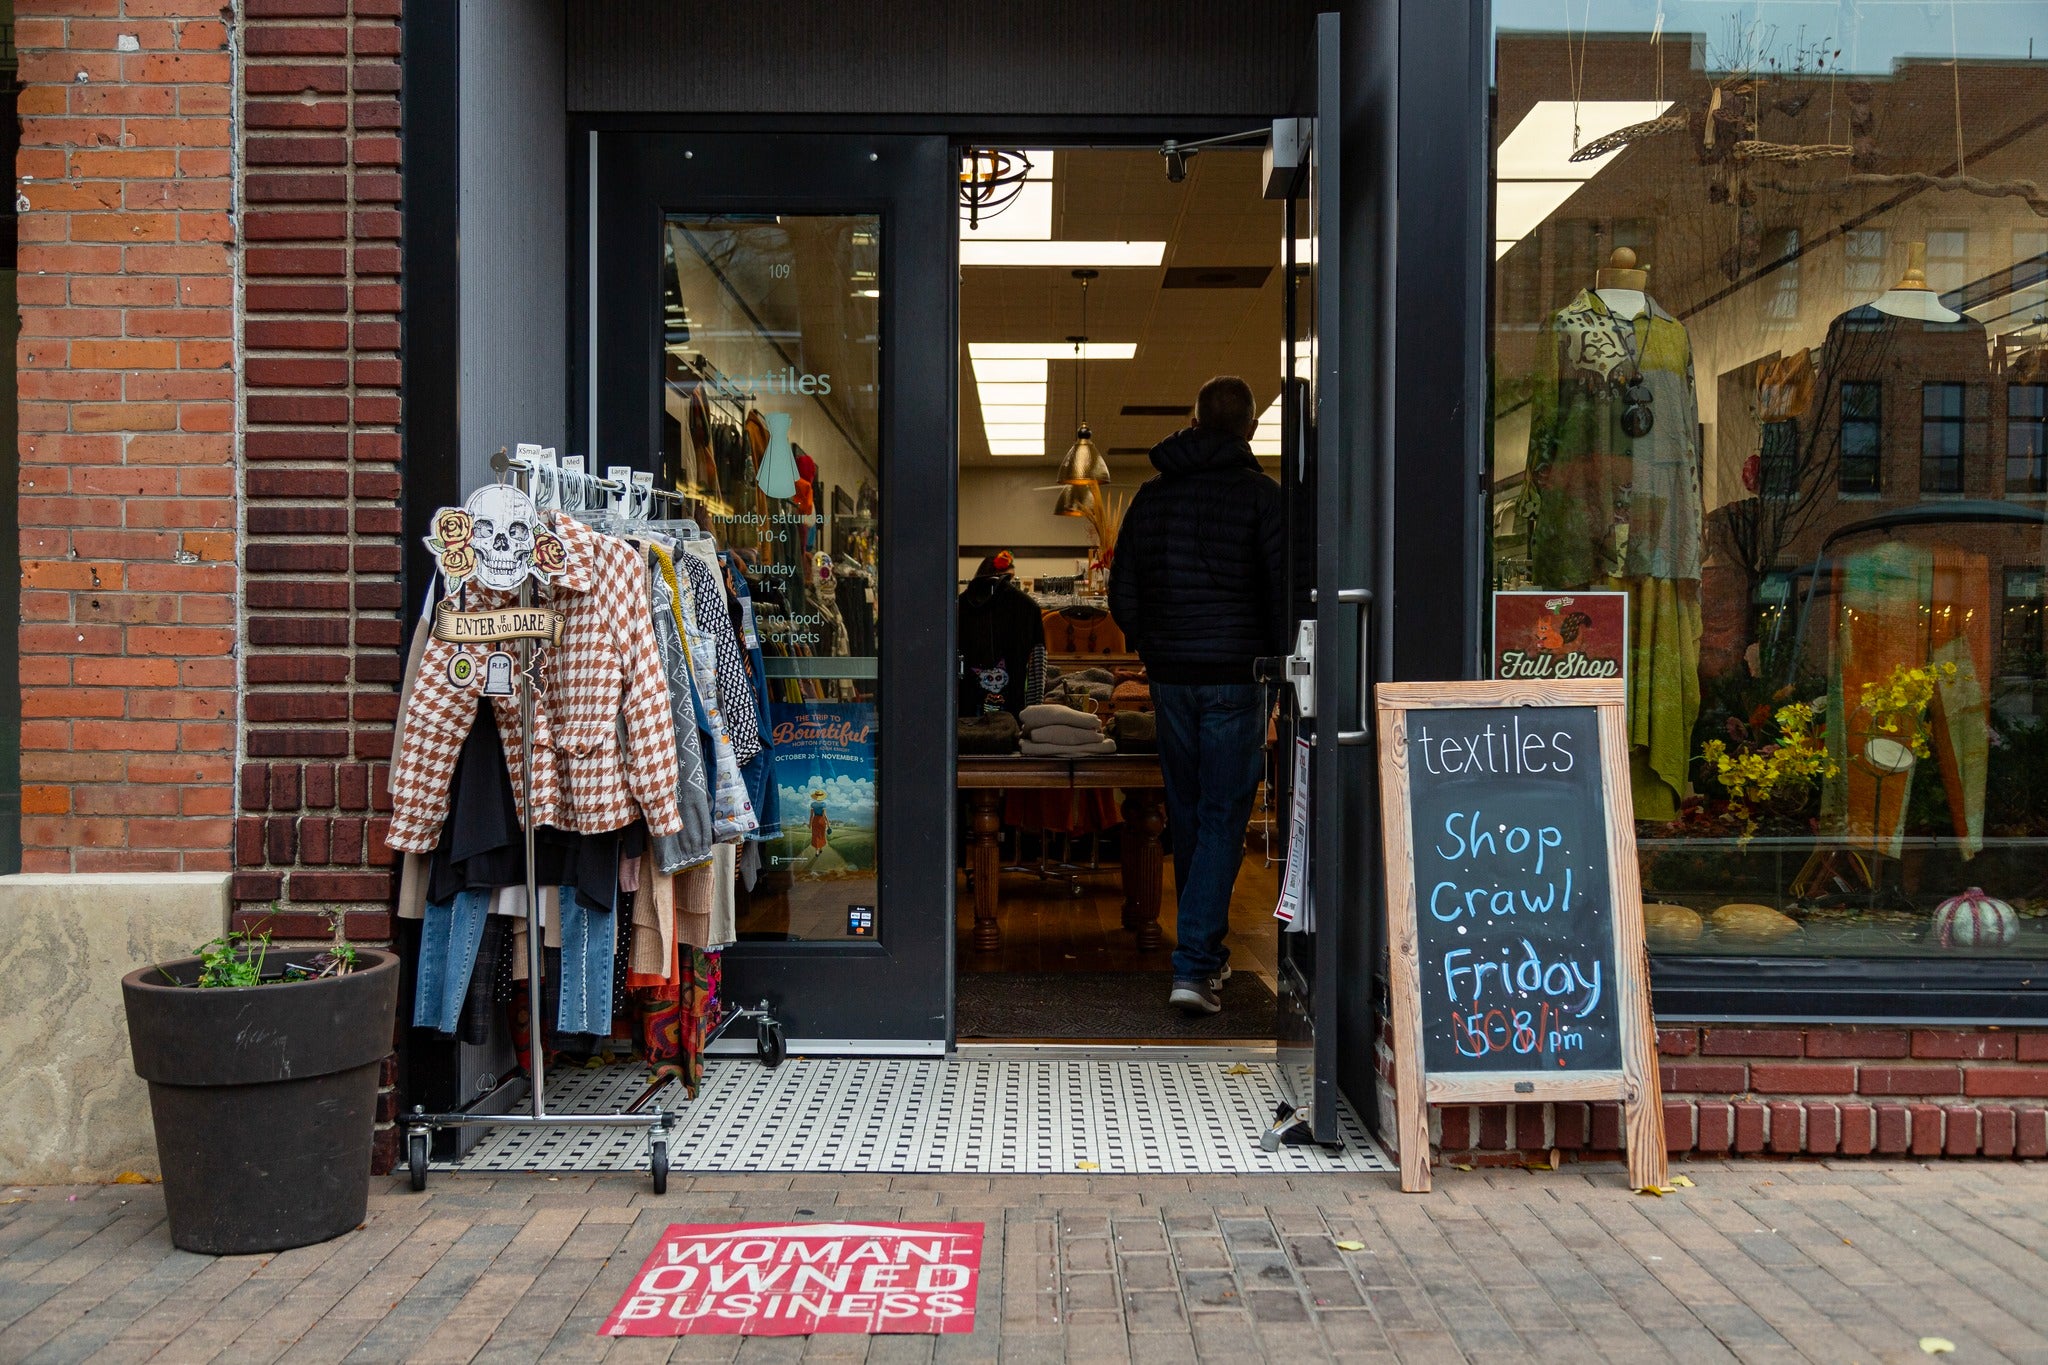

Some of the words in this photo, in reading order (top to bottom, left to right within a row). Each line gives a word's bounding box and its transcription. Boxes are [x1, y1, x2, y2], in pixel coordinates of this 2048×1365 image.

[769, 263, 790, 279] 109
[714, 366, 832, 397] textiles
[611, 468, 628, 476] Large
[713, 511, 832, 527] monday-saturay
[758, 530, 788, 543] 10-6
[748, 562, 797, 577] sunday
[758, 581, 788, 593] 11-4
[456, 617, 496, 636] ENTER
[500, 614, 507, 623] IF
[513, 614, 545, 631] DARE
[768, 614, 785, 624] no
[790, 612, 825, 626] food,
[497, 623, 512, 633] YOU
[771, 633, 785, 643] or
[790, 632, 820, 645] pets
[1501, 652, 1552, 678] Fall
[1554, 652, 1618, 679] Shop
[831, 714, 841, 723] TO
[772, 721, 870, 747] Bountiful
[1418, 715, 1574, 775] textiles
[775, 753, 807, 762] OCTOBER
[821, 753, 859, 763] NOVEMBER
[1436, 811, 1562, 875] Shop
[1430, 868, 1572, 922] Crawl
[1444, 936, 1601, 1018] Friday
[1549, 1030, 1583, 1053] pm
[666, 1240, 974, 1265] WOMAN-
[638, 1263, 971, 1294] OWNED
[619, 1293, 964, 1319] BUSINESS
